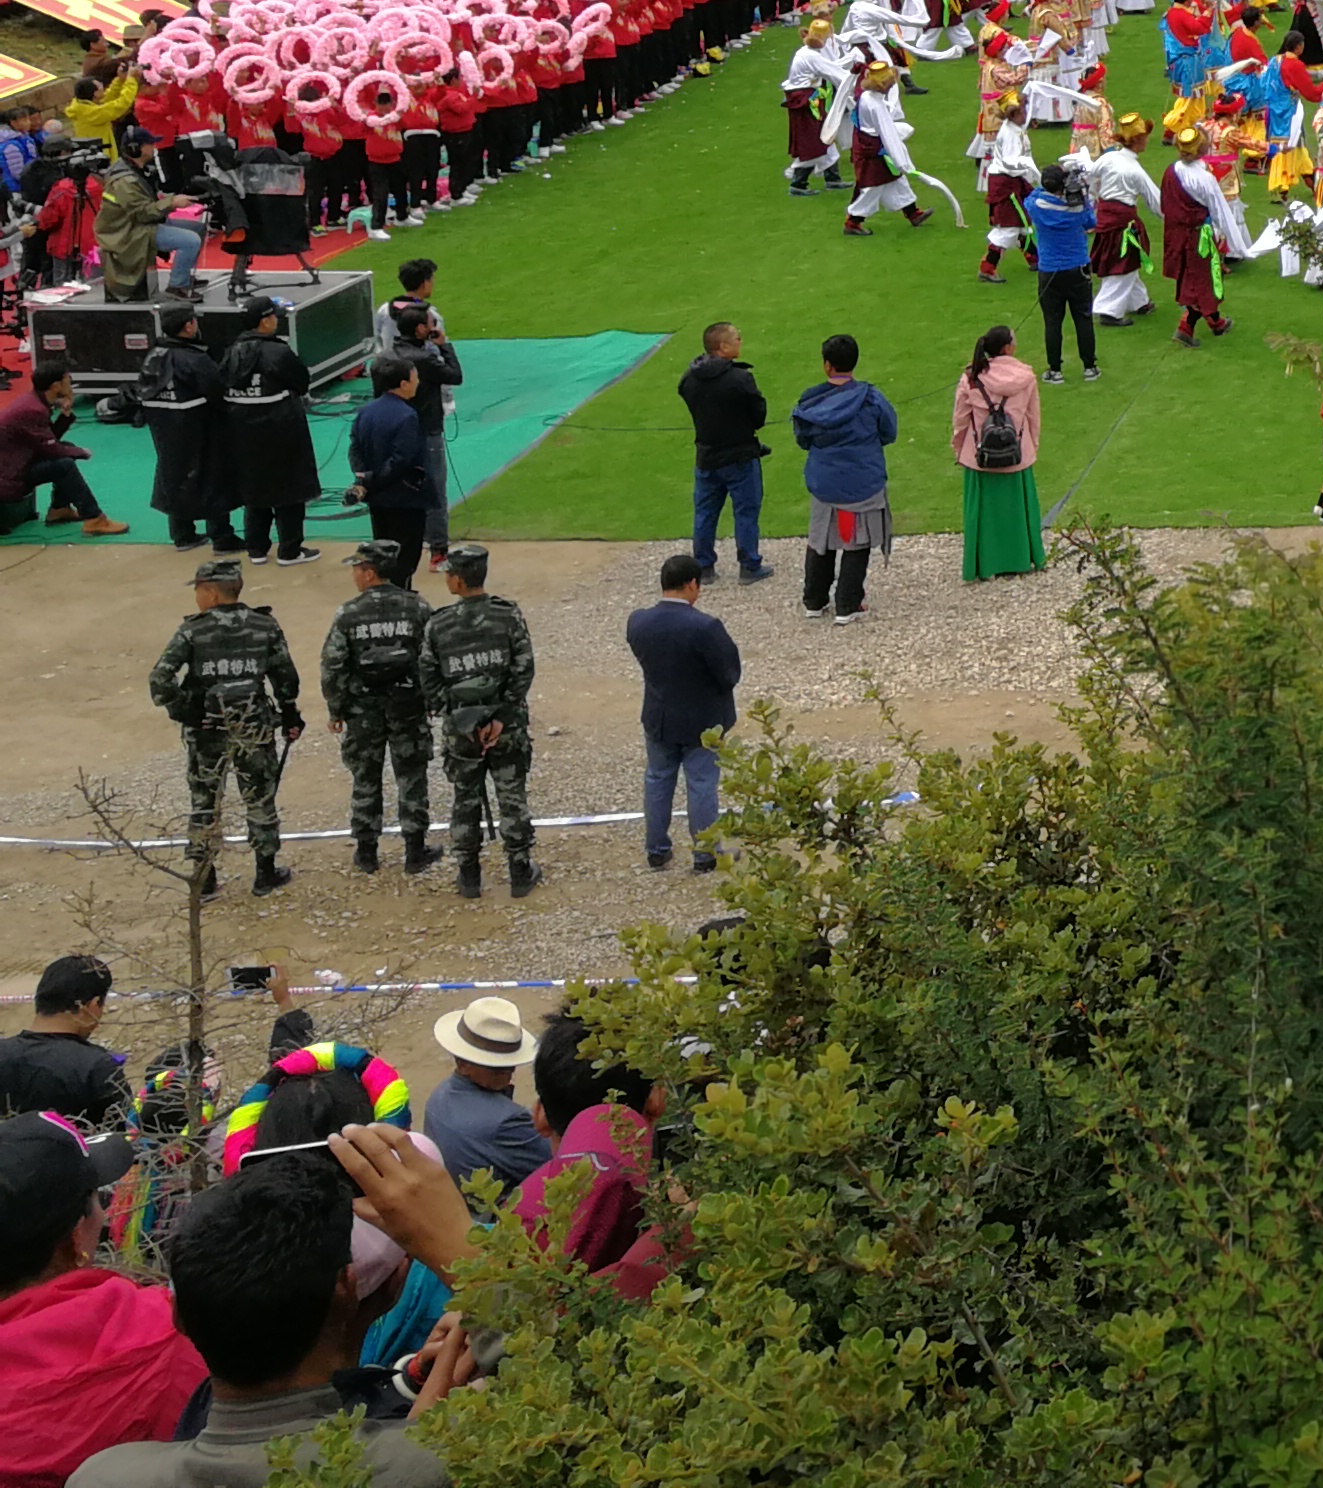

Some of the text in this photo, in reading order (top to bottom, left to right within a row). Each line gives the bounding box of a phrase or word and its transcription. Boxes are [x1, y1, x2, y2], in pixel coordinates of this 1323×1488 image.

[355, 620, 409, 640] 武警特战
[201, 658, 258, 676] 武警特战
[448, 649, 503, 674] 武警特战
